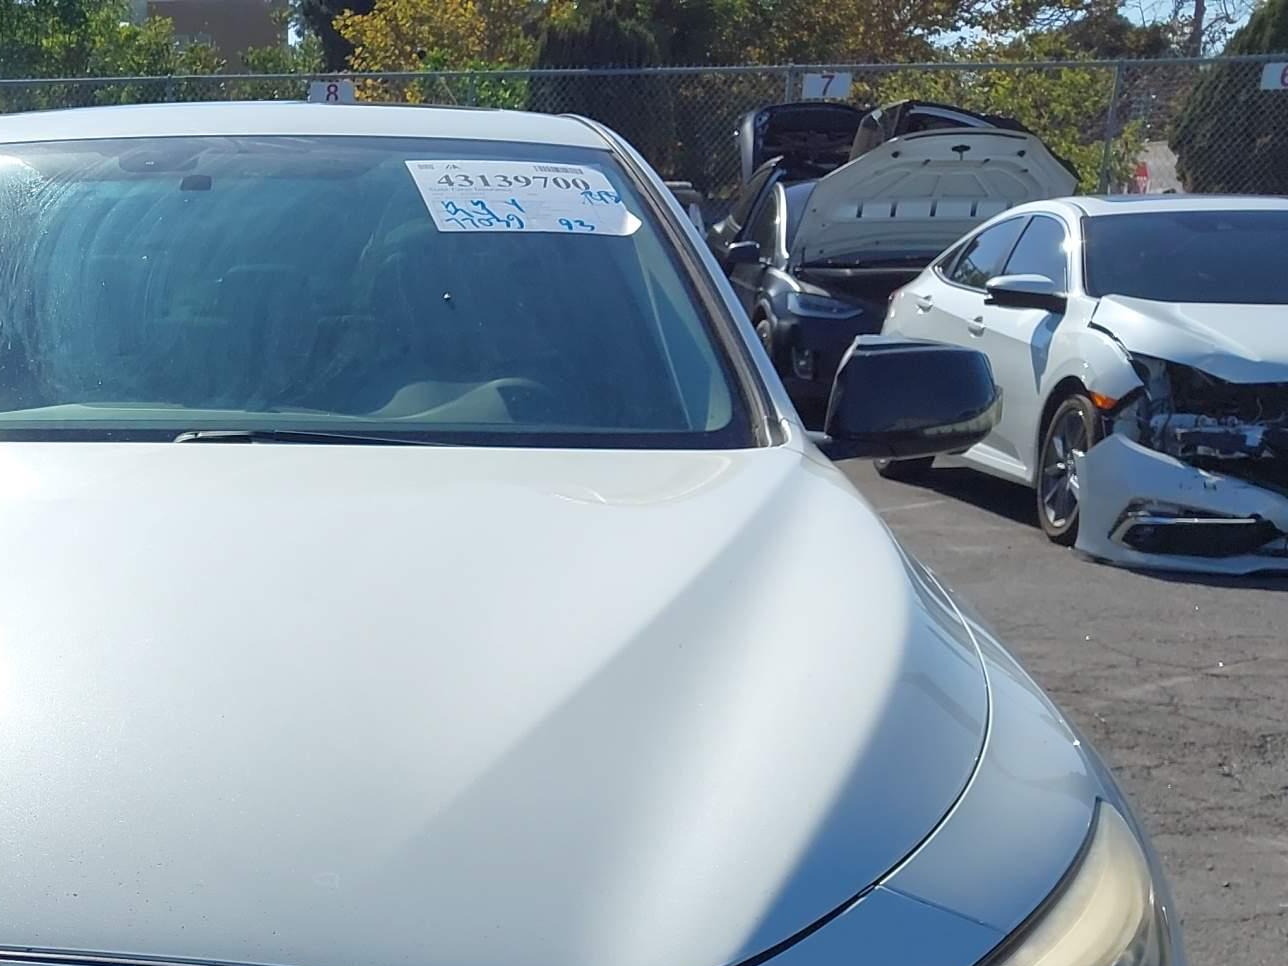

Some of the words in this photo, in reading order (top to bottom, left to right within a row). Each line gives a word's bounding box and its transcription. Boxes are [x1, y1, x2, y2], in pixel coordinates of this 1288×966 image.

[327, 84, 338, 102] 8
[821, 75, 834, 97] 7
[437, 174, 590, 191] 43139700
